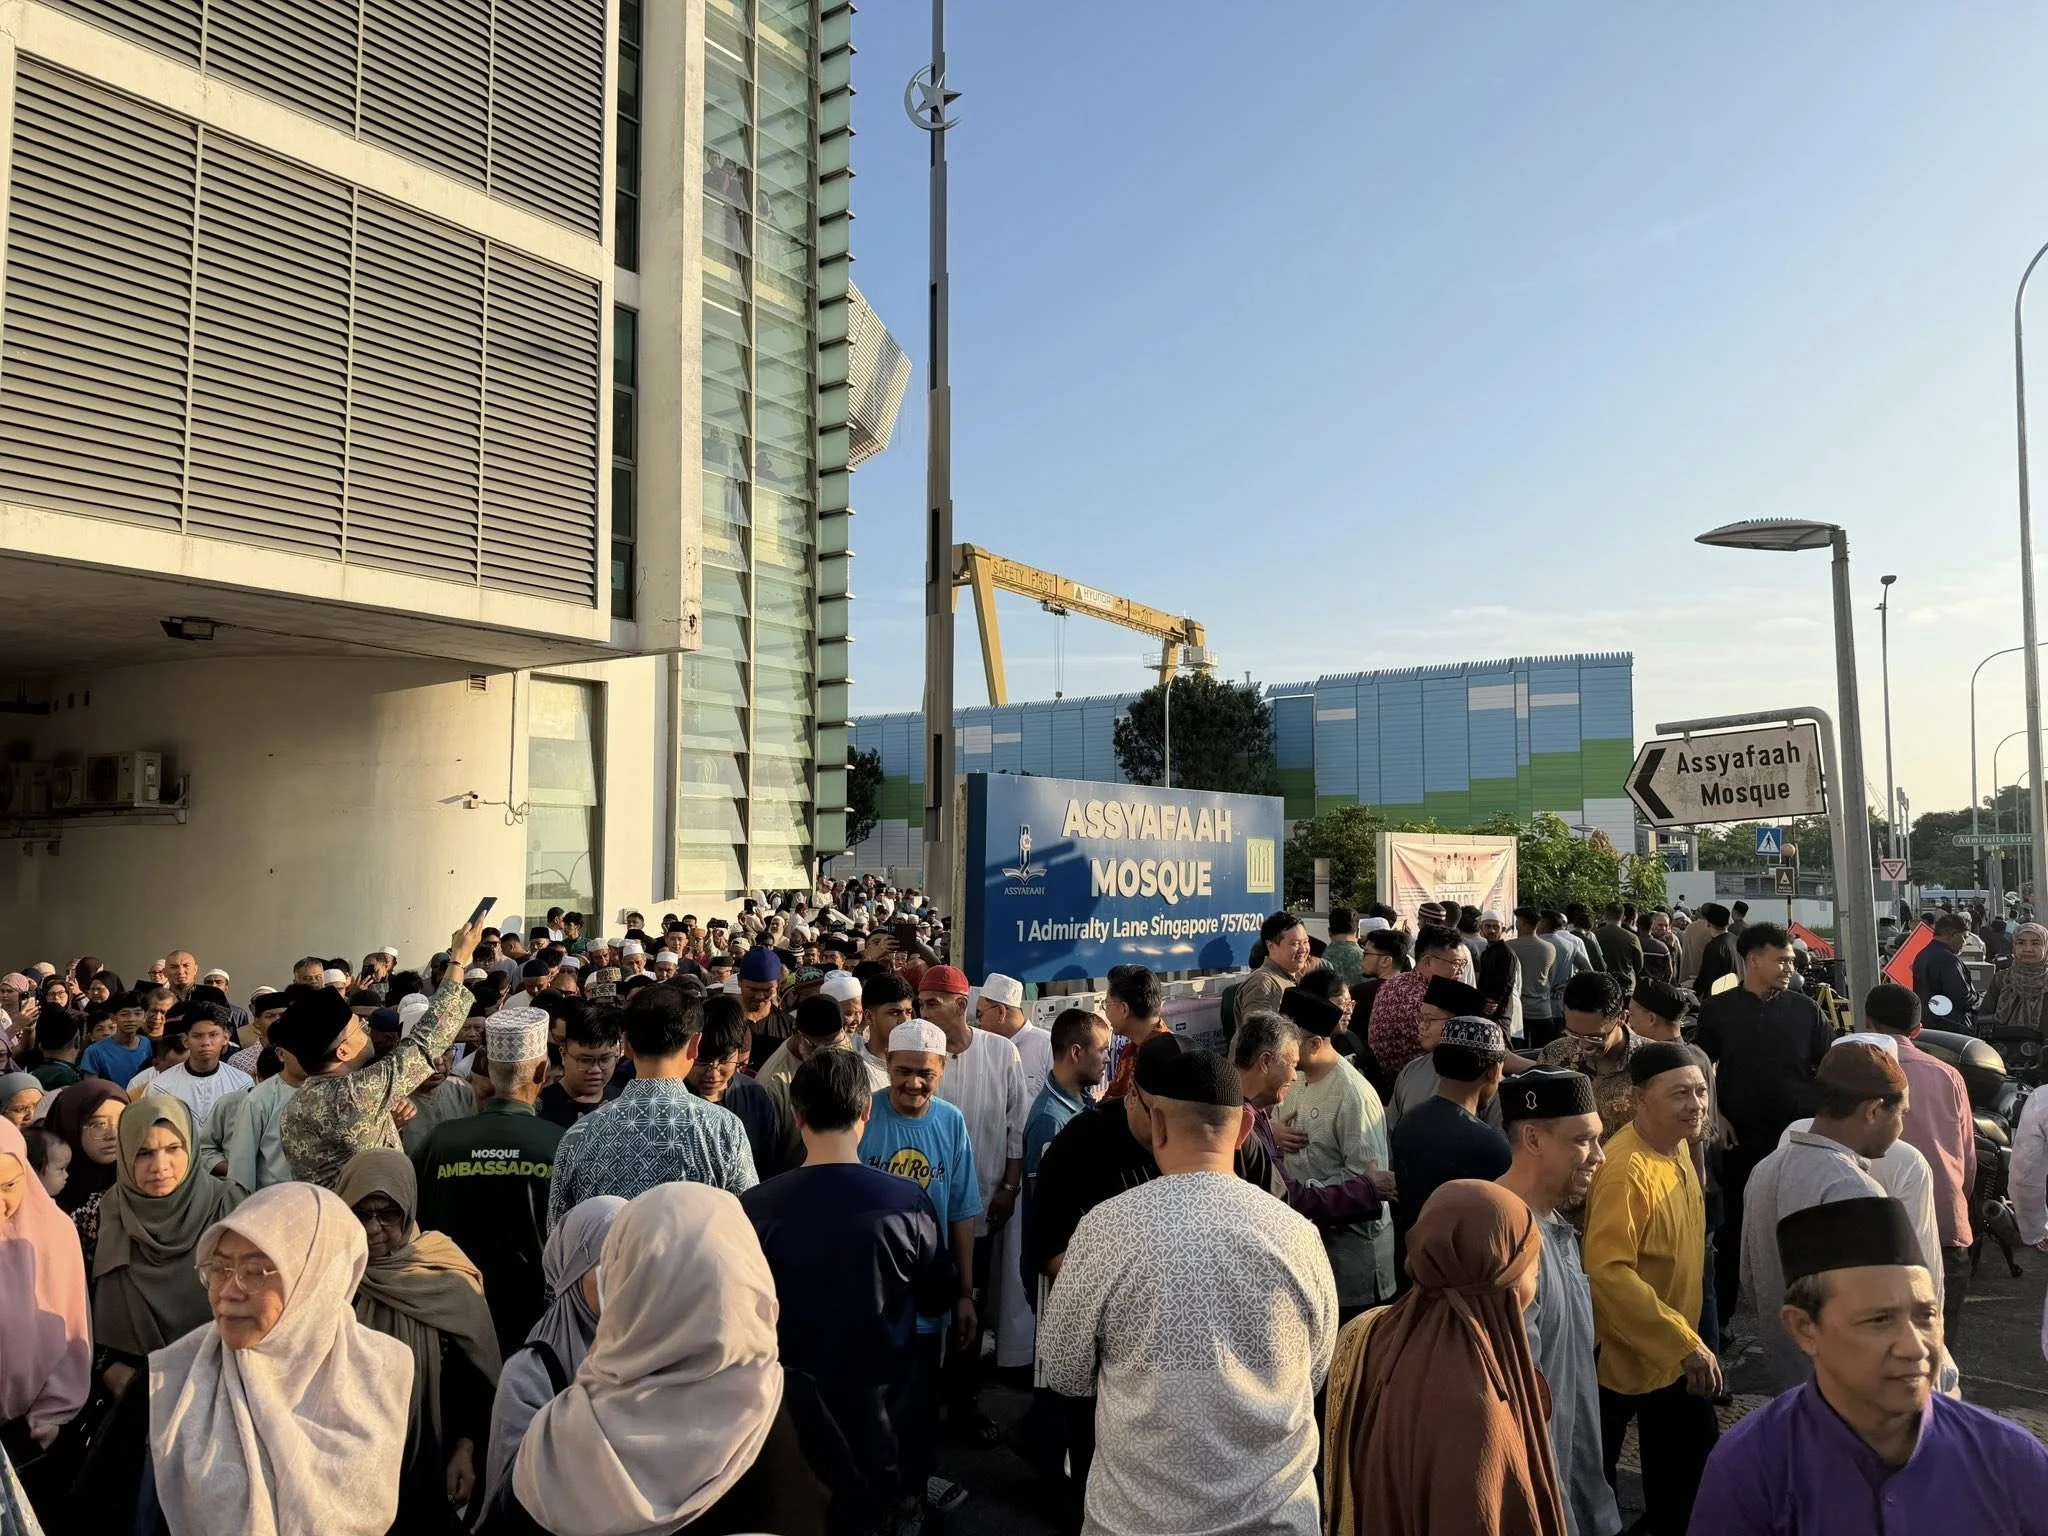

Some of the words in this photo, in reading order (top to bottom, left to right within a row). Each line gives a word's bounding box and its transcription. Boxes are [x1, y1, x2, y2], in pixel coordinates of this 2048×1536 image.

[993, 561, 1025, 582] SAFETY
[1031, 573, 1053, 592] FIRST
[1676, 740, 1801, 777] Assyafaah
[1700, 782, 1790, 808] Mosque
[1061, 799, 1232, 843] ASSYAFAAH
[1958, 835, 2006, 845] Admiralty
[1003, 886, 1045, 896] ASSYAFAAH
[1091, 858, 1212, 905] MOSQUE
[1016, 920, 1024, 942] 1
[1027, 917, 1110, 944] Admiralty
[1113, 917, 1149, 938] Lane
[1150, 913, 1219, 940] Singapore
[1220, 912, 1264, 933] 757620
[471, 1149, 520, 1160] MOSQUE
[868, 1155, 909, 1176] Hard
[908, 1158, 946, 1183] Rock
